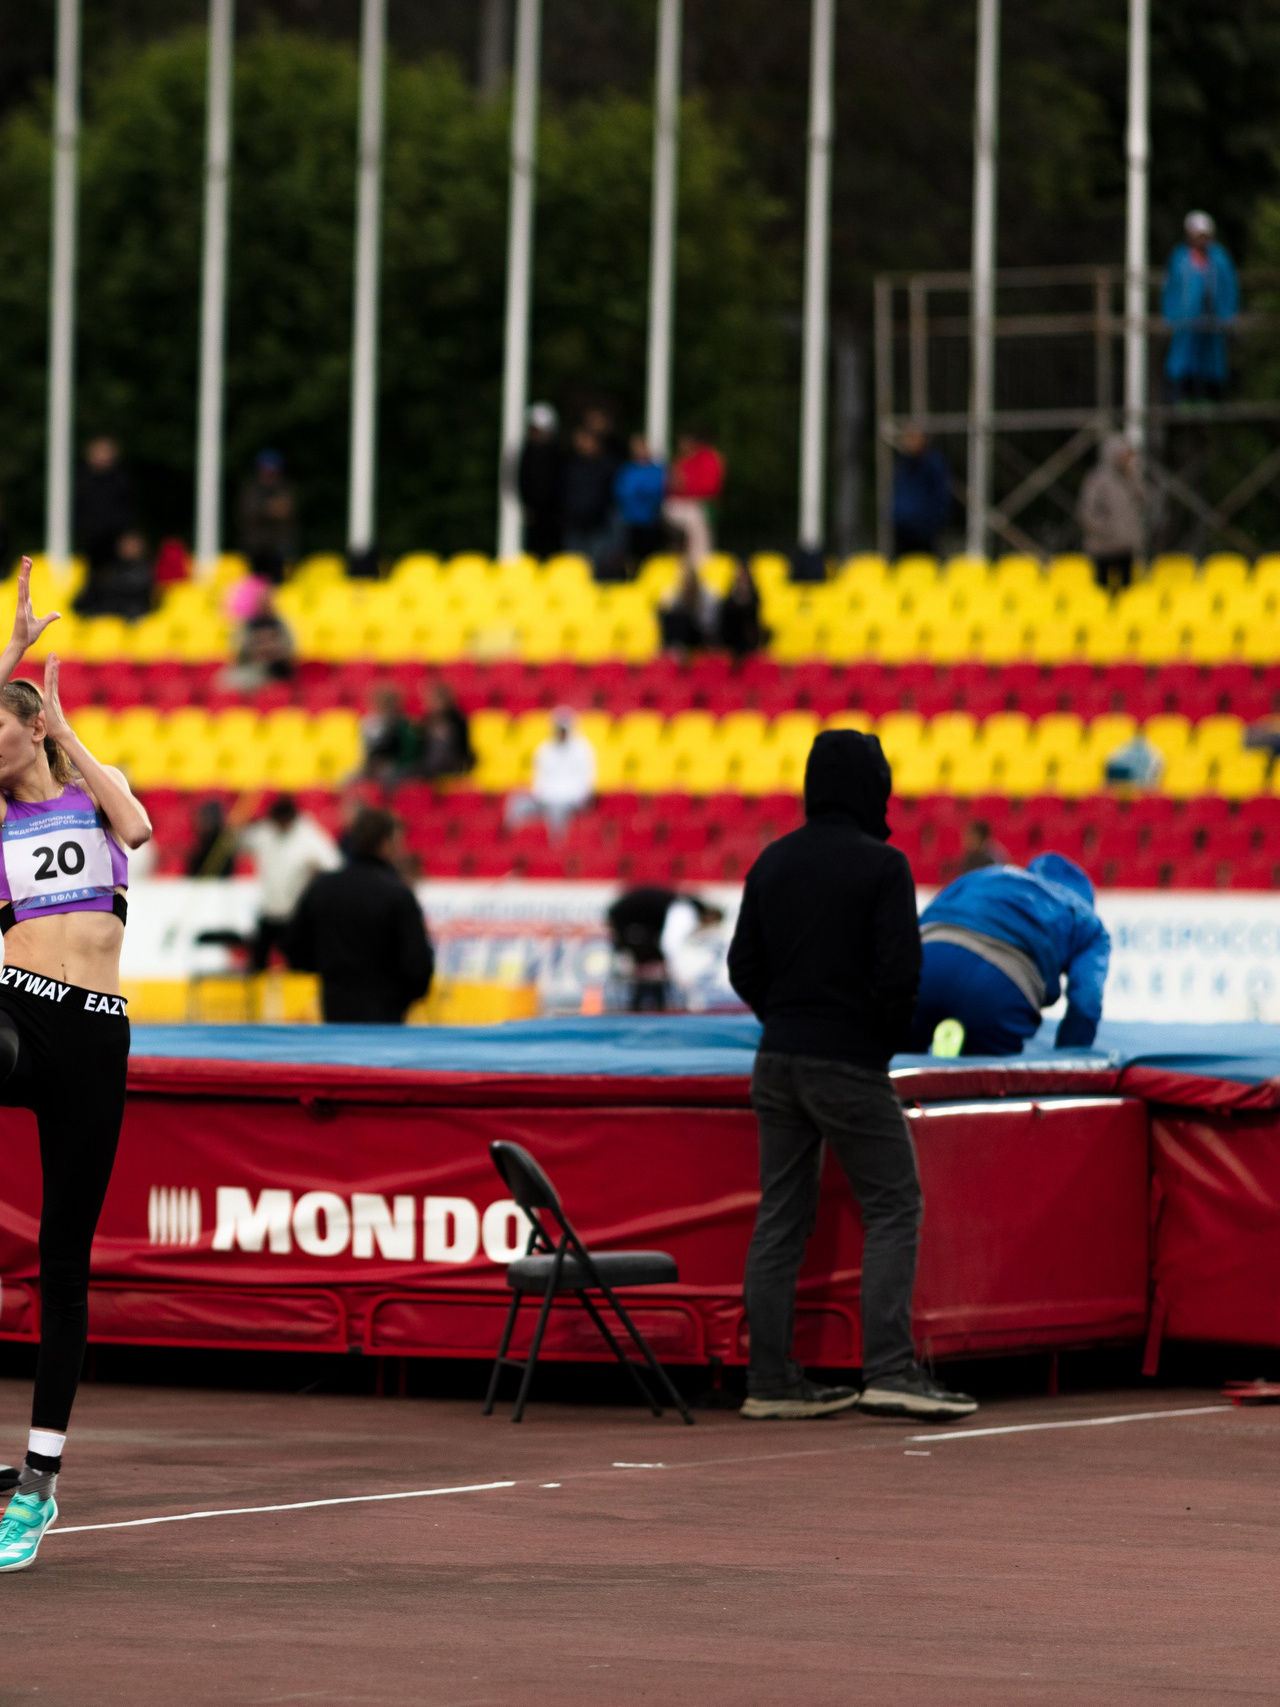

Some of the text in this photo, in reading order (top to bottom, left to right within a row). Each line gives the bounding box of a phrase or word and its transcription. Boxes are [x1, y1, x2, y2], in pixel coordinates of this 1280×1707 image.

[8, 819, 69, 836] ФЕДЕРАЛЬНОГО
[29, 815, 75, 827] ЧЕМПИОНАТ
[32, 841, 85, 881] 20
[51, 893, 78, 903] ВФЛА
[212, 1185, 535, 1264] MONDO
